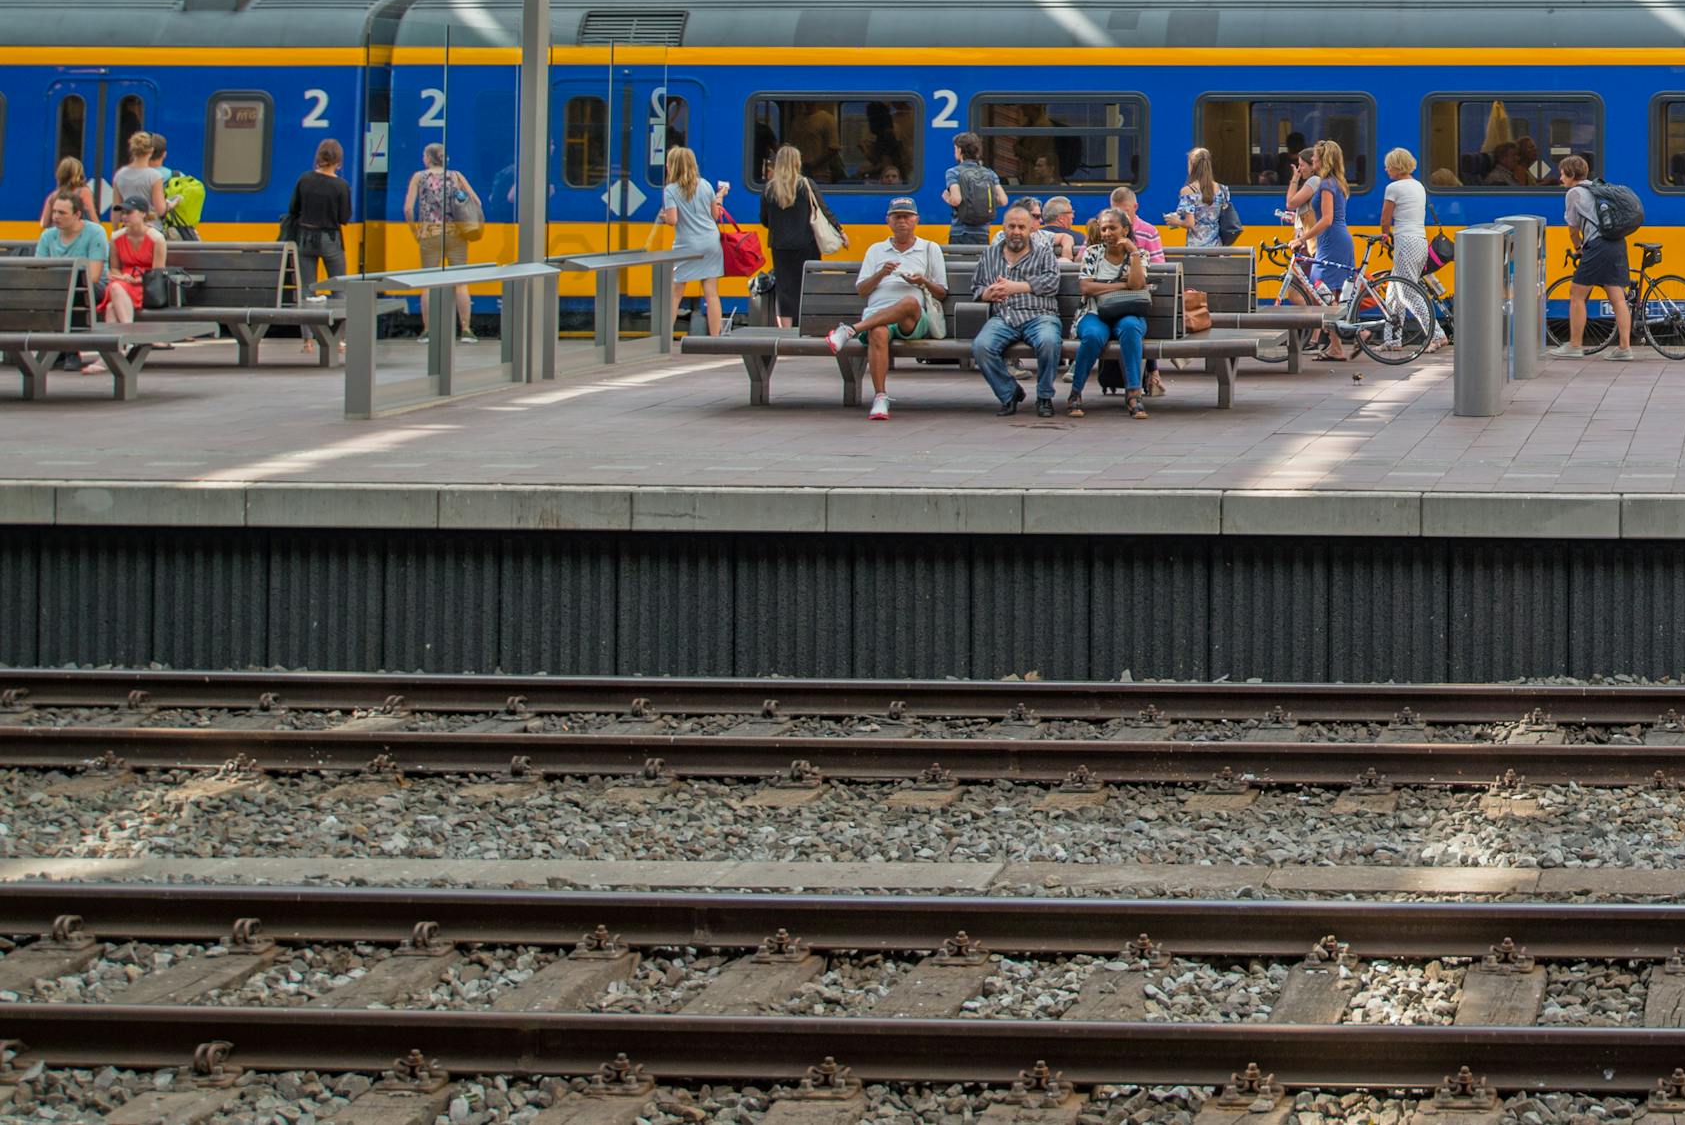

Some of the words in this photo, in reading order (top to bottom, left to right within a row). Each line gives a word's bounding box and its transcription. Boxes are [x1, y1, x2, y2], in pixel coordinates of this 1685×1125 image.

[302, 89, 330, 128] 2
[419, 88, 445, 127] 2
[931, 89, 959, 128] 2
